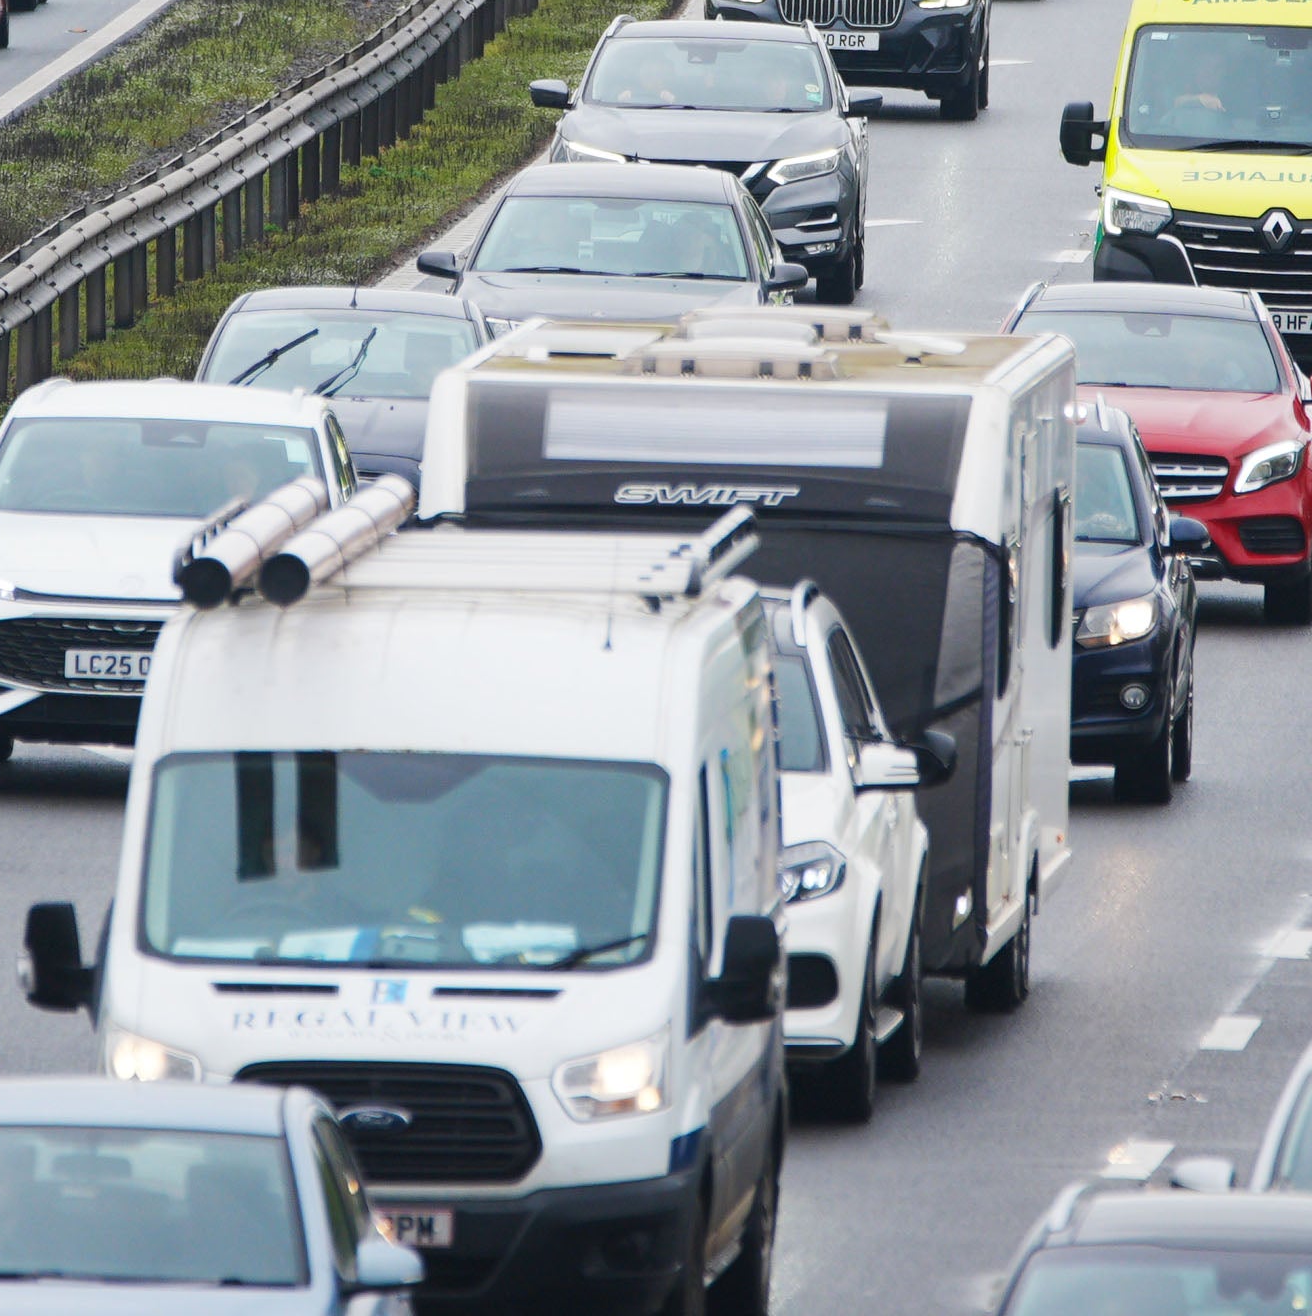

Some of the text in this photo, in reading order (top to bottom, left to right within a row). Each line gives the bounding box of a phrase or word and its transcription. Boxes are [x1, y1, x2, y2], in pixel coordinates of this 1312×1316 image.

[839, 34, 866, 47] RGR
[613, 483, 801, 506] SWIFT
[75, 655, 132, 675] LC25
